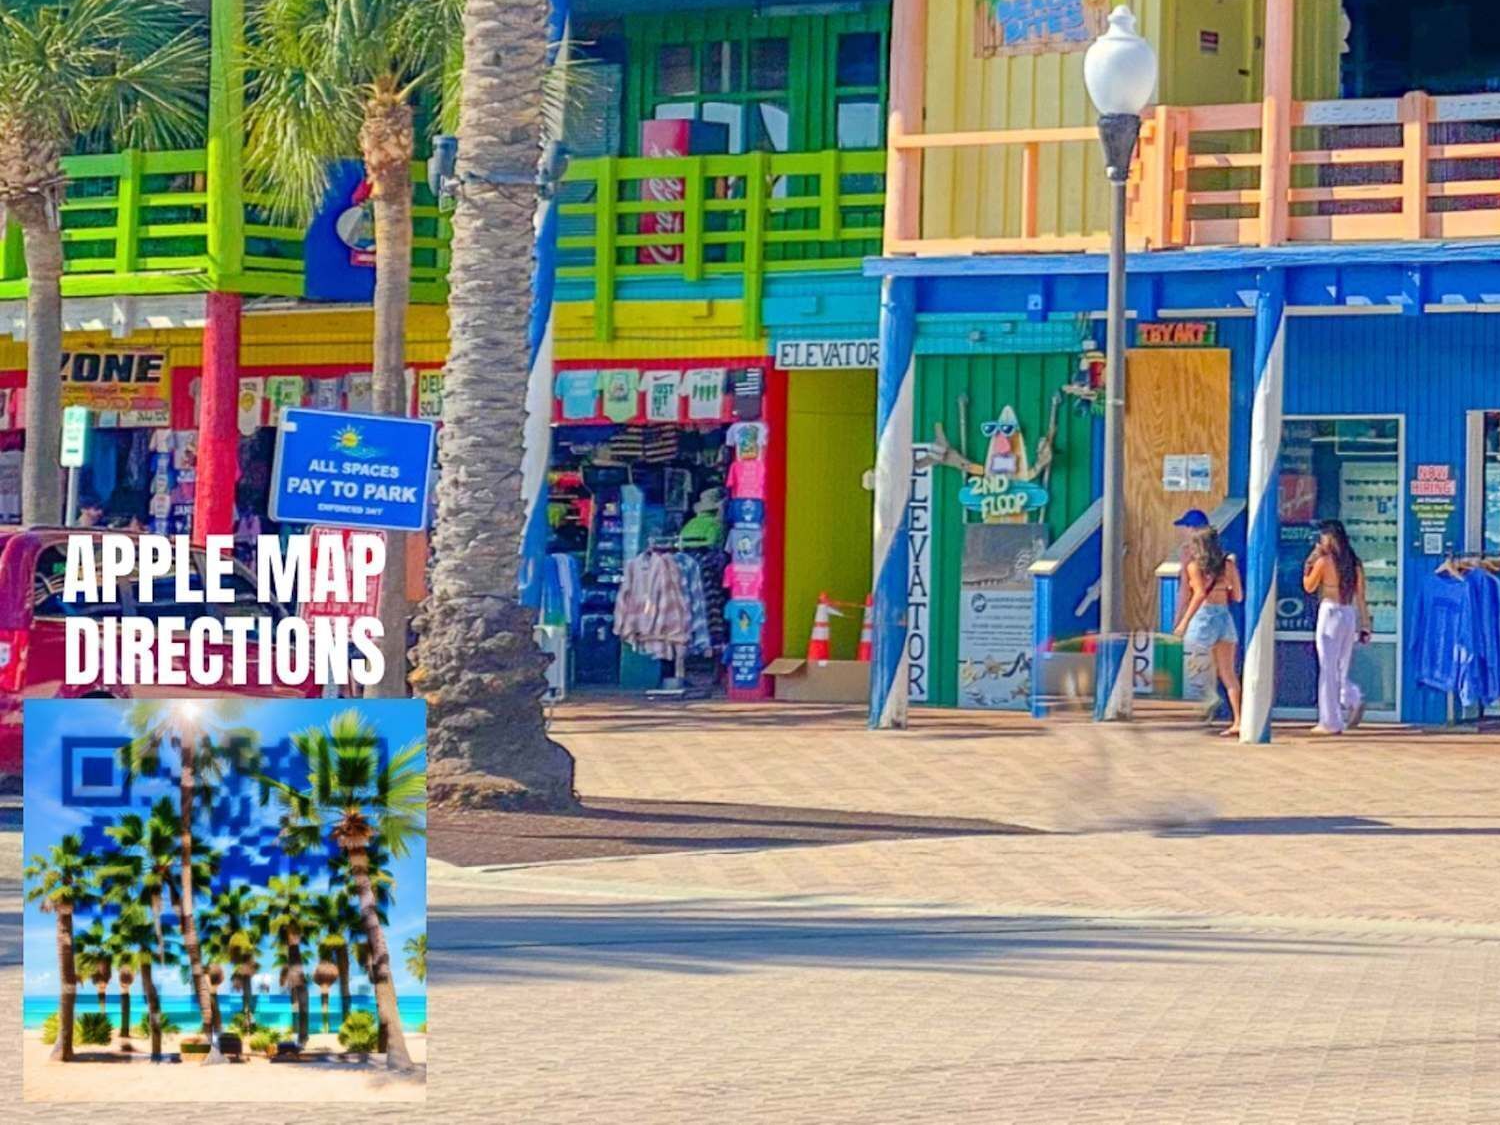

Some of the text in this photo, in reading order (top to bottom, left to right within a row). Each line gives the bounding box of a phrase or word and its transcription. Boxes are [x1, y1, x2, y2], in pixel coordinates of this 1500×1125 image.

[779, 342, 880, 367] ELEVATOR
[308, 459, 400, 479] ALL SPACES
[286, 477, 417, 504] PAY TO PARK
[968, 475, 1009, 495] 2ND
[907, 448, 929, 695] ELEVATOR
